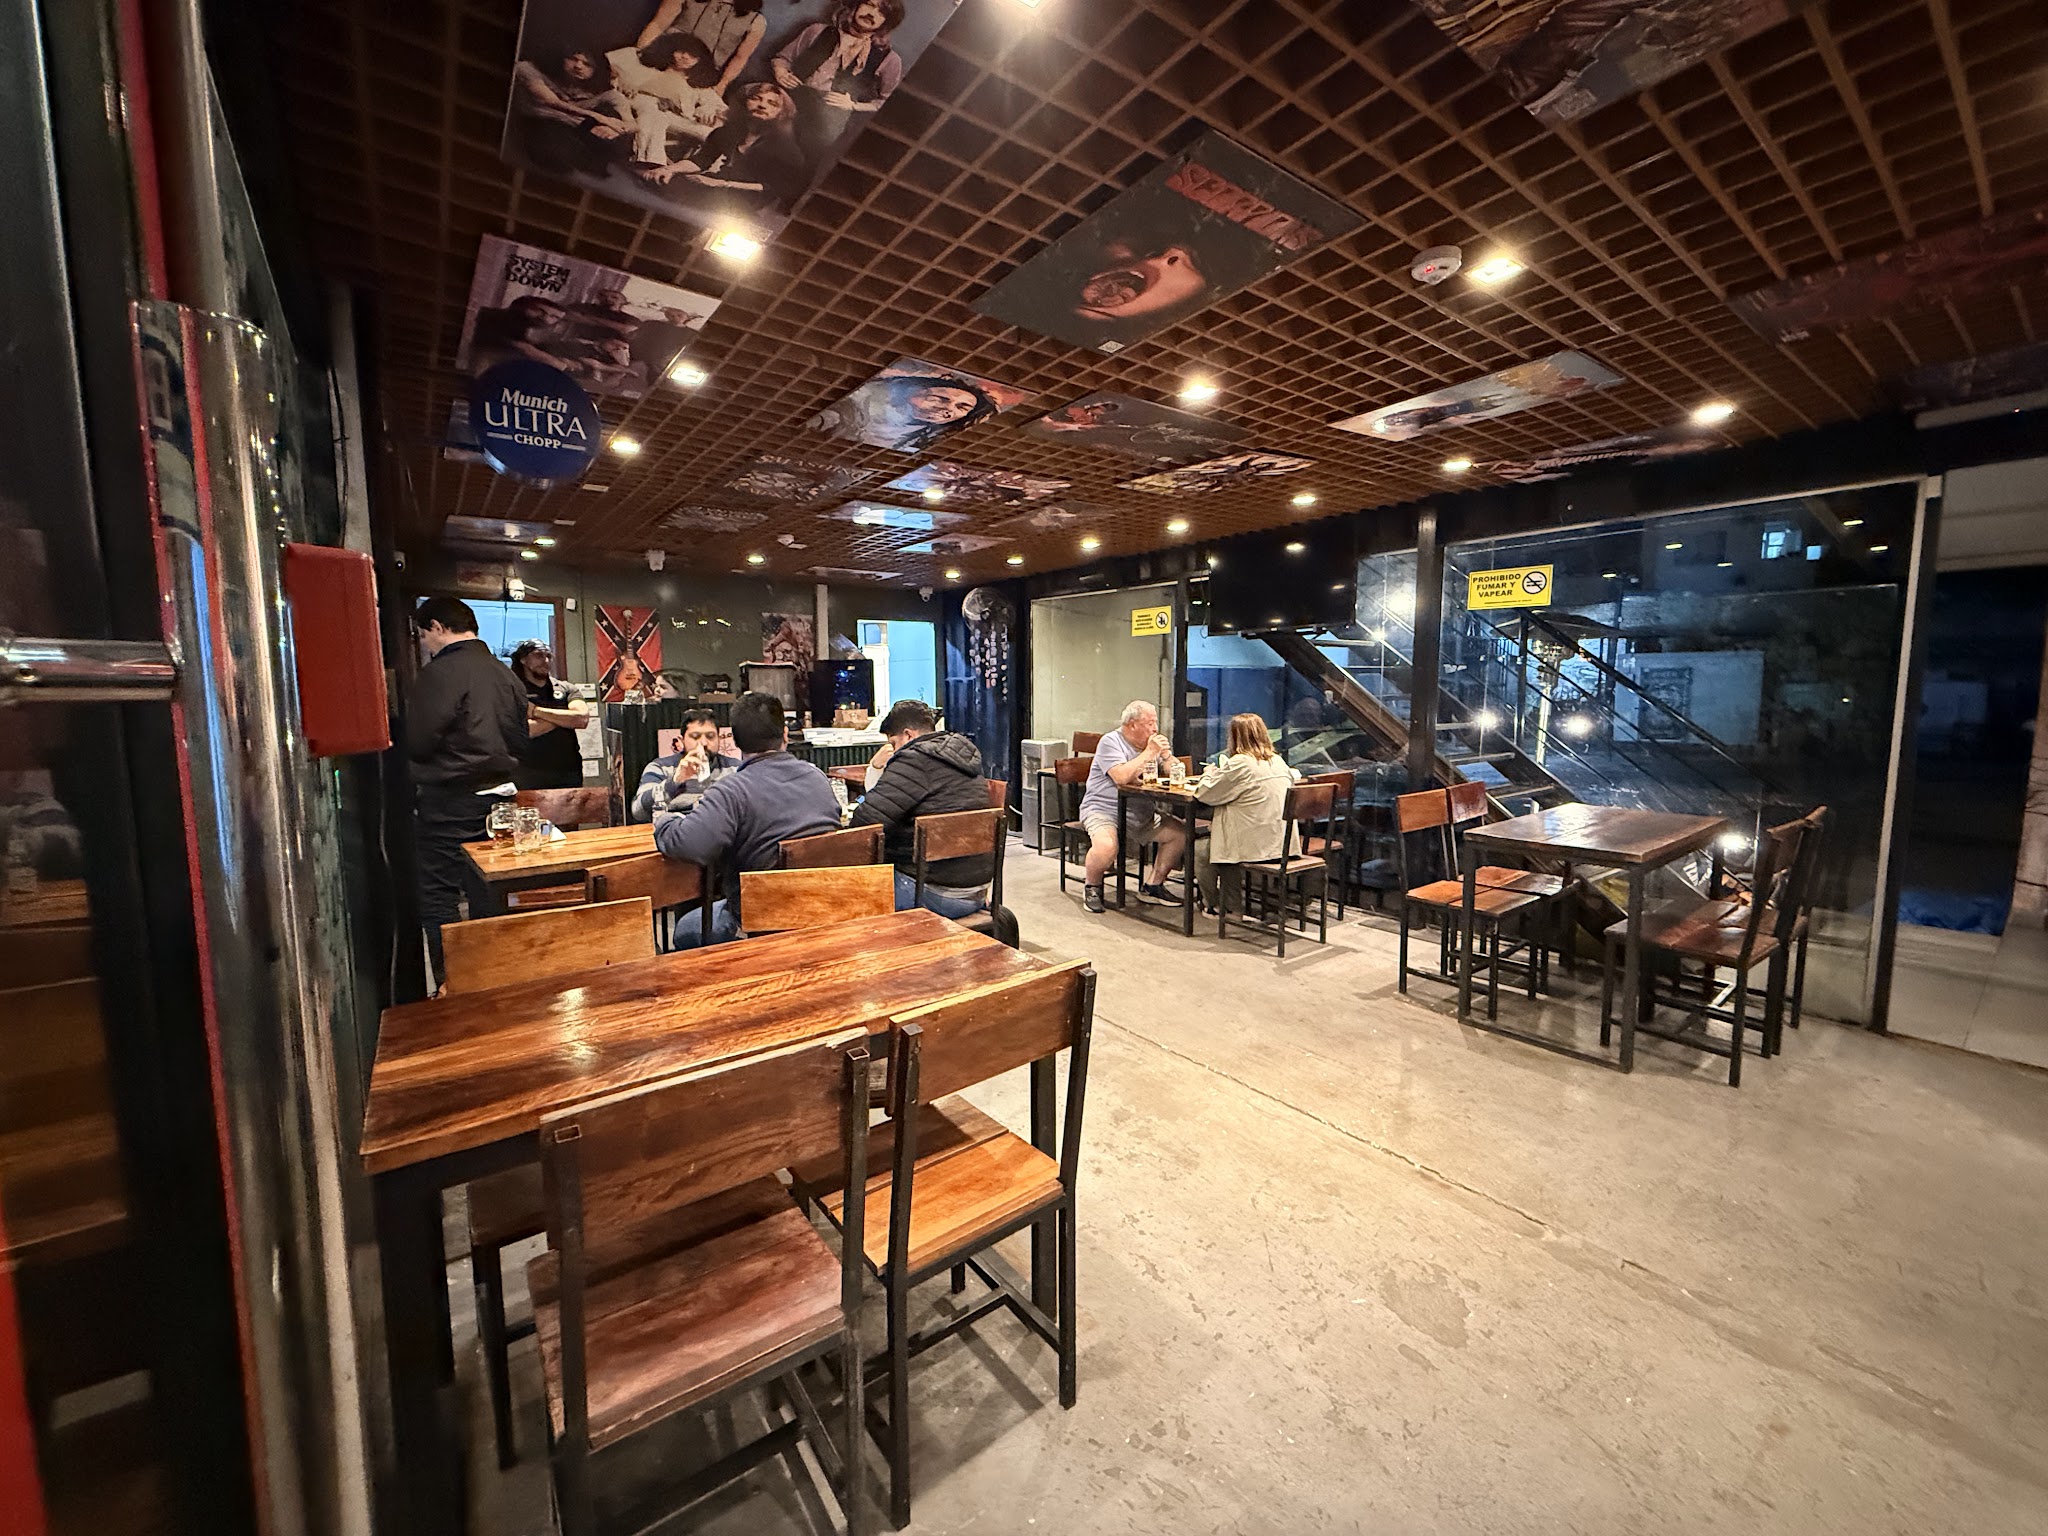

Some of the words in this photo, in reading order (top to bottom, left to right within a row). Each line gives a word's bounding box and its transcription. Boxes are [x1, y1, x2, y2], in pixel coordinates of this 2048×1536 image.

[506, 253, 571, 278] SYSTEM
[505, 272, 563, 293] DOWN
[501, 387, 568, 413] Munich
[484, 401, 587, 440] ULTRA
[514, 433, 561, 449] CHOPP
[1472, 573, 1521, 583] PROHIBIDO
[1476, 582, 1507, 590] FUMAR
[1478, 589, 1513, 598] VAPEAR
